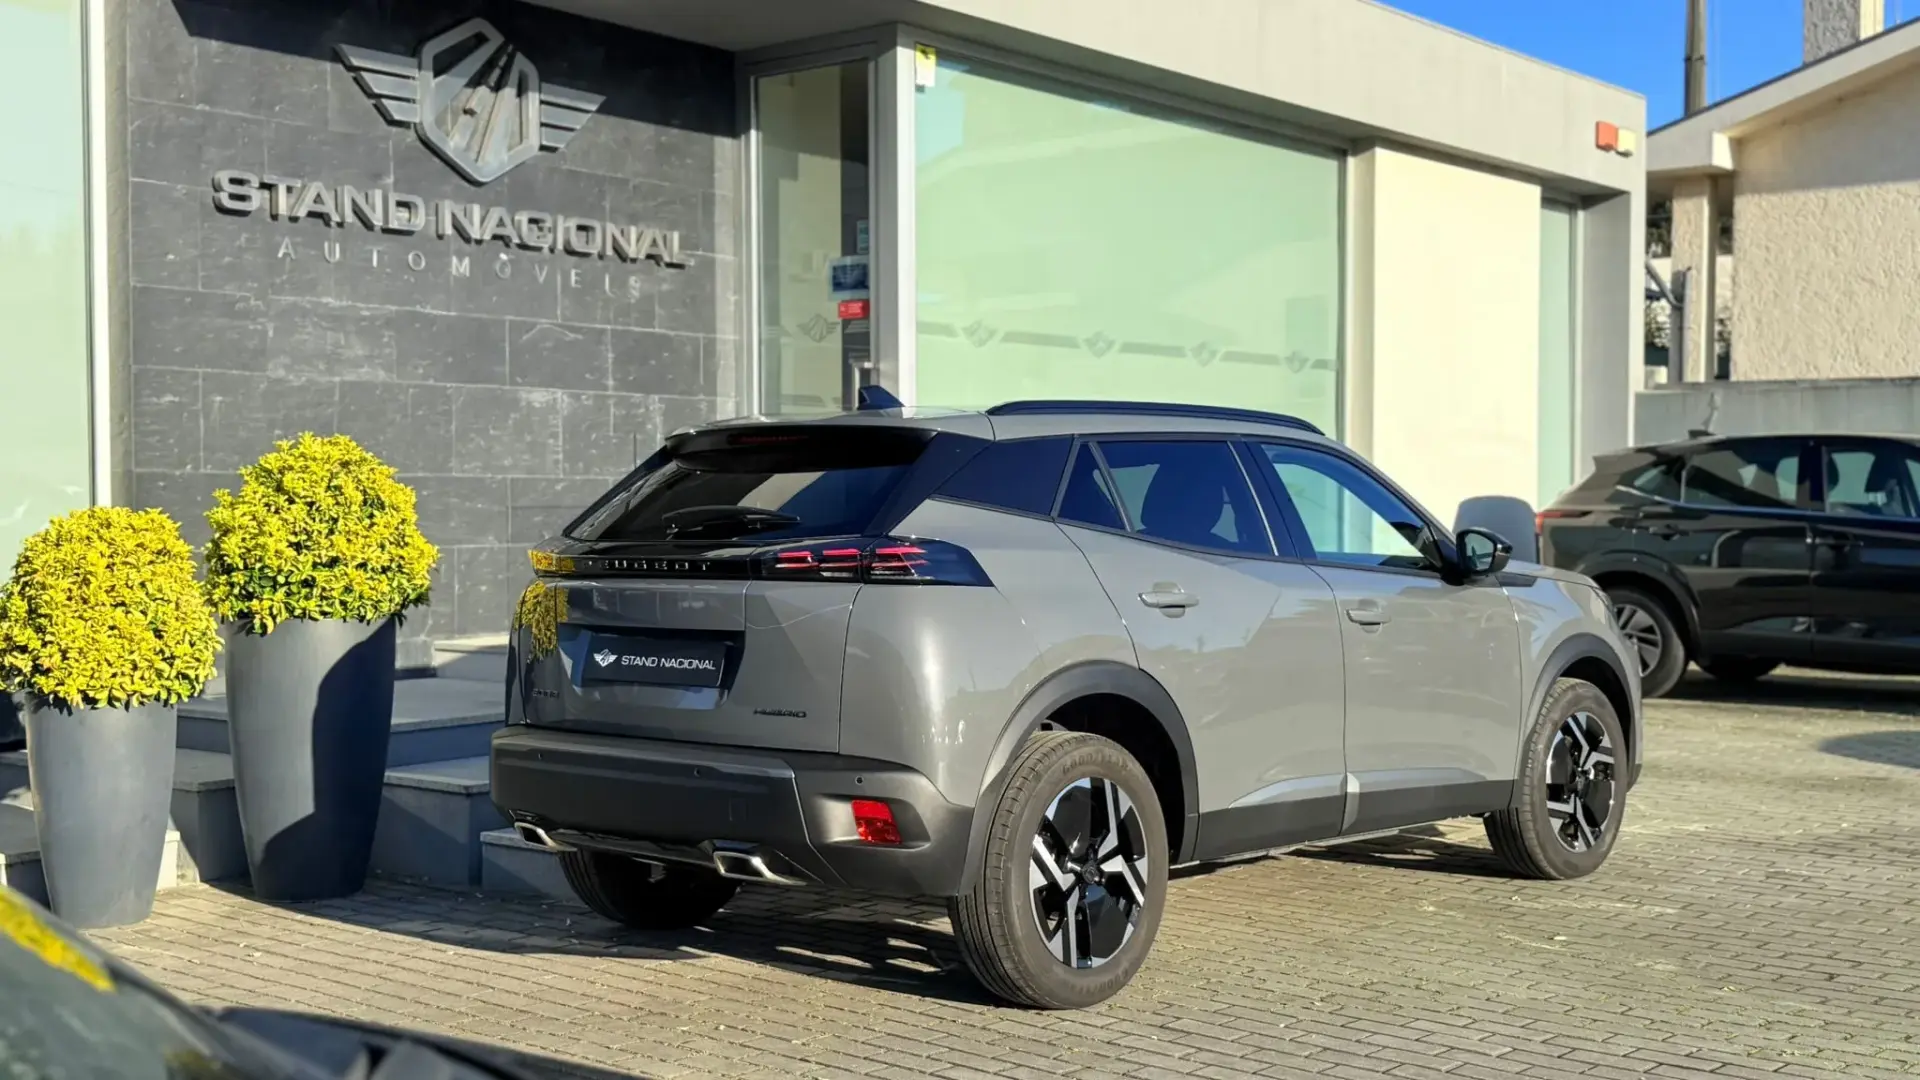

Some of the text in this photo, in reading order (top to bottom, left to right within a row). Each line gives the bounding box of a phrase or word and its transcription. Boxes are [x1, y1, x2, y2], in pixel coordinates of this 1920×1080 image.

[213, 170, 695, 268] STAND NACIONAL
[621, 655, 716, 670] STAND NACIONAL
